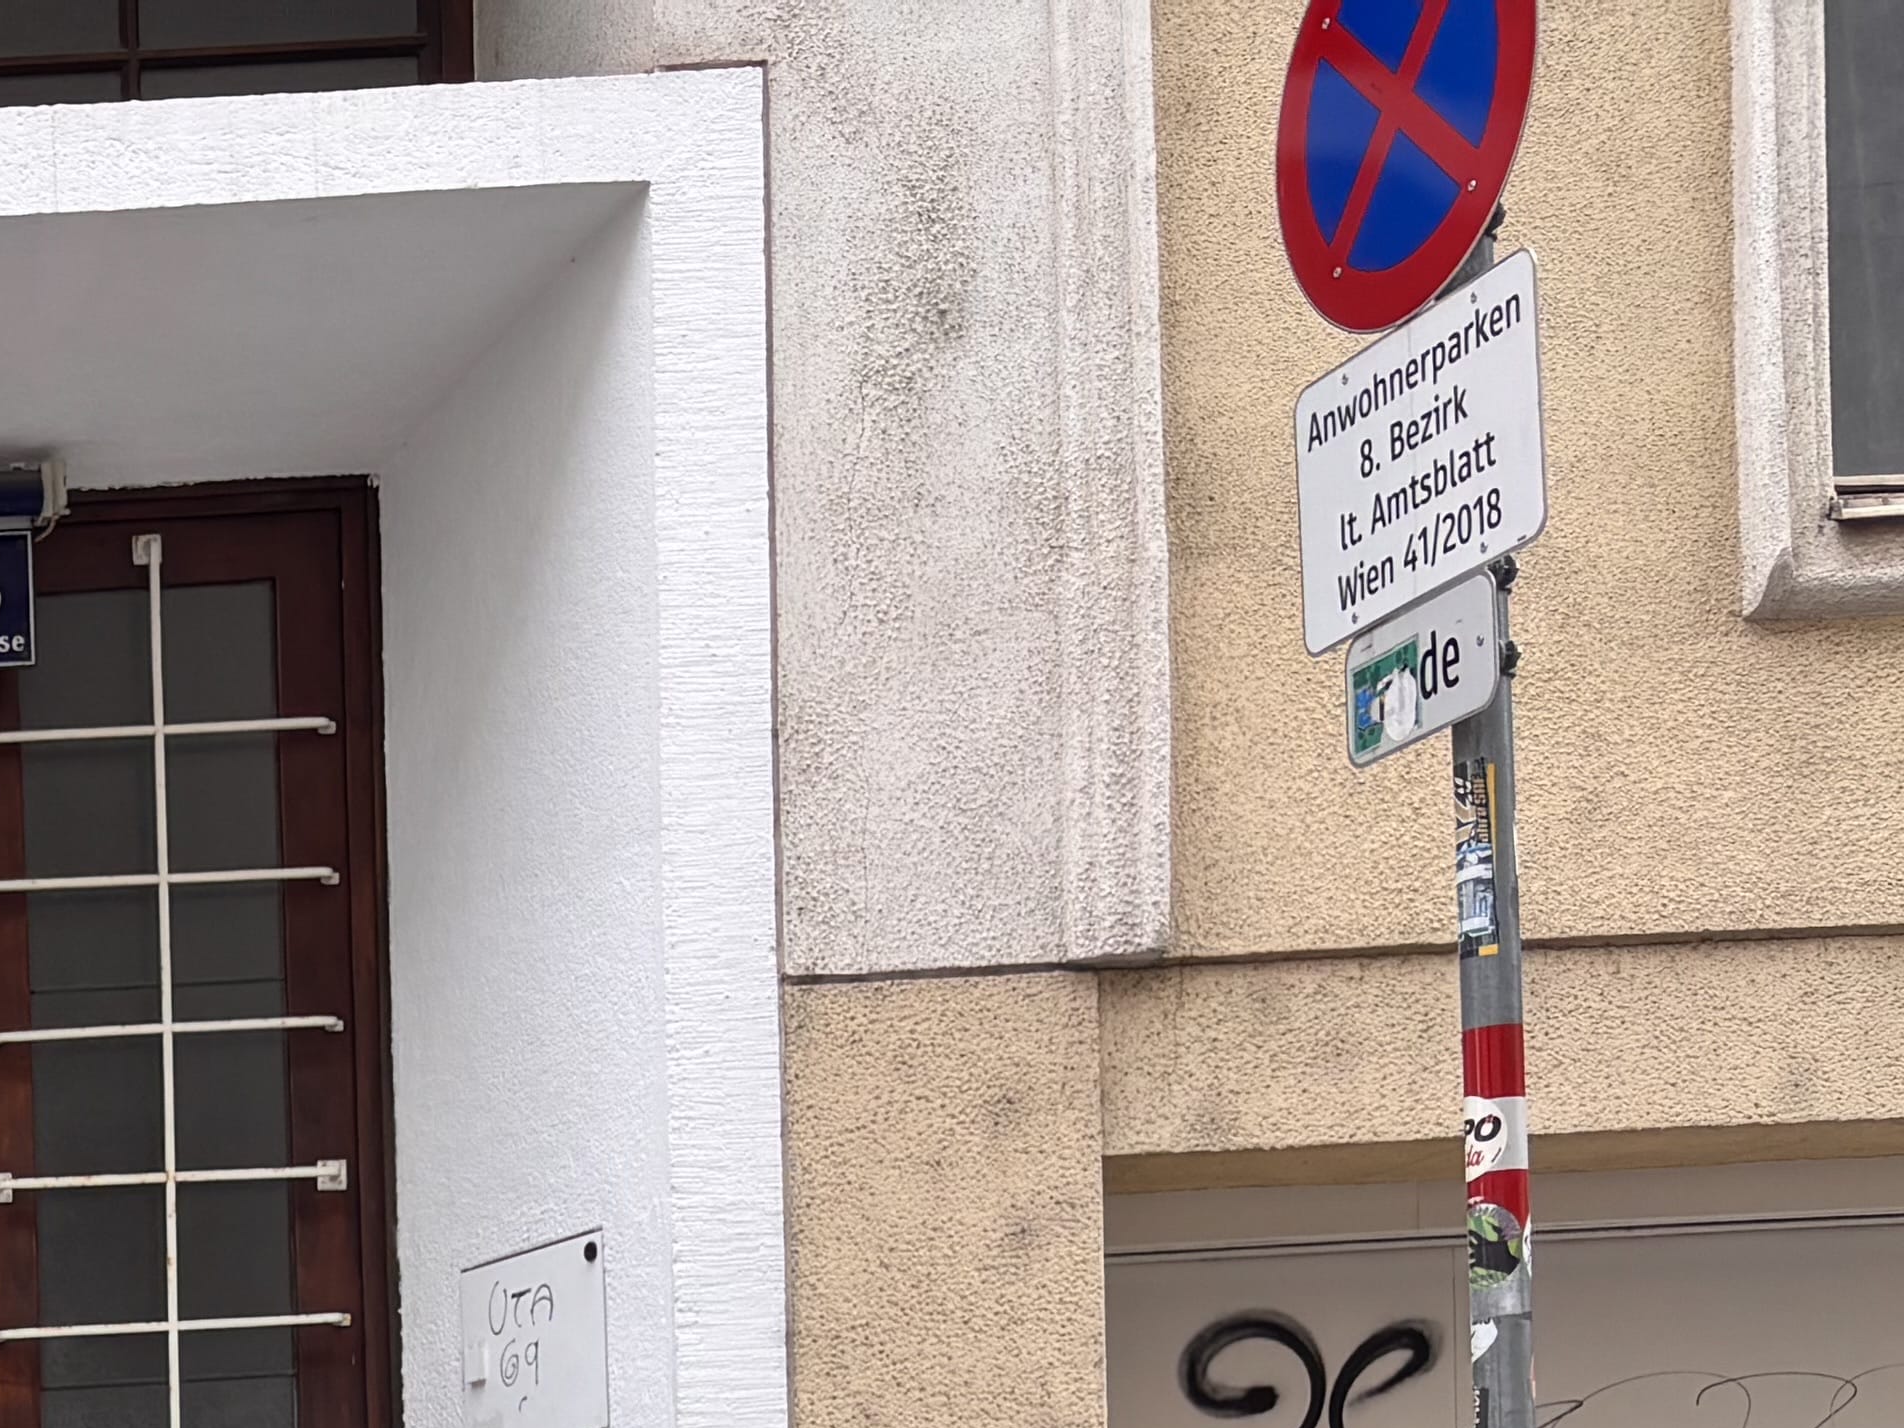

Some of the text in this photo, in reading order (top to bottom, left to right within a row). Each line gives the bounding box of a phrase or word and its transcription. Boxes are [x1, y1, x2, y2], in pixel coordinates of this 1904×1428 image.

[1306, 291, 1522, 454] Anwohnerparken
[1359, 384, 1469, 480] 8. Bezirk
[1337, 488, 1503, 613] Wien 41/2018
[1339, 432, 1498, 553] lt. Amtsblatt
